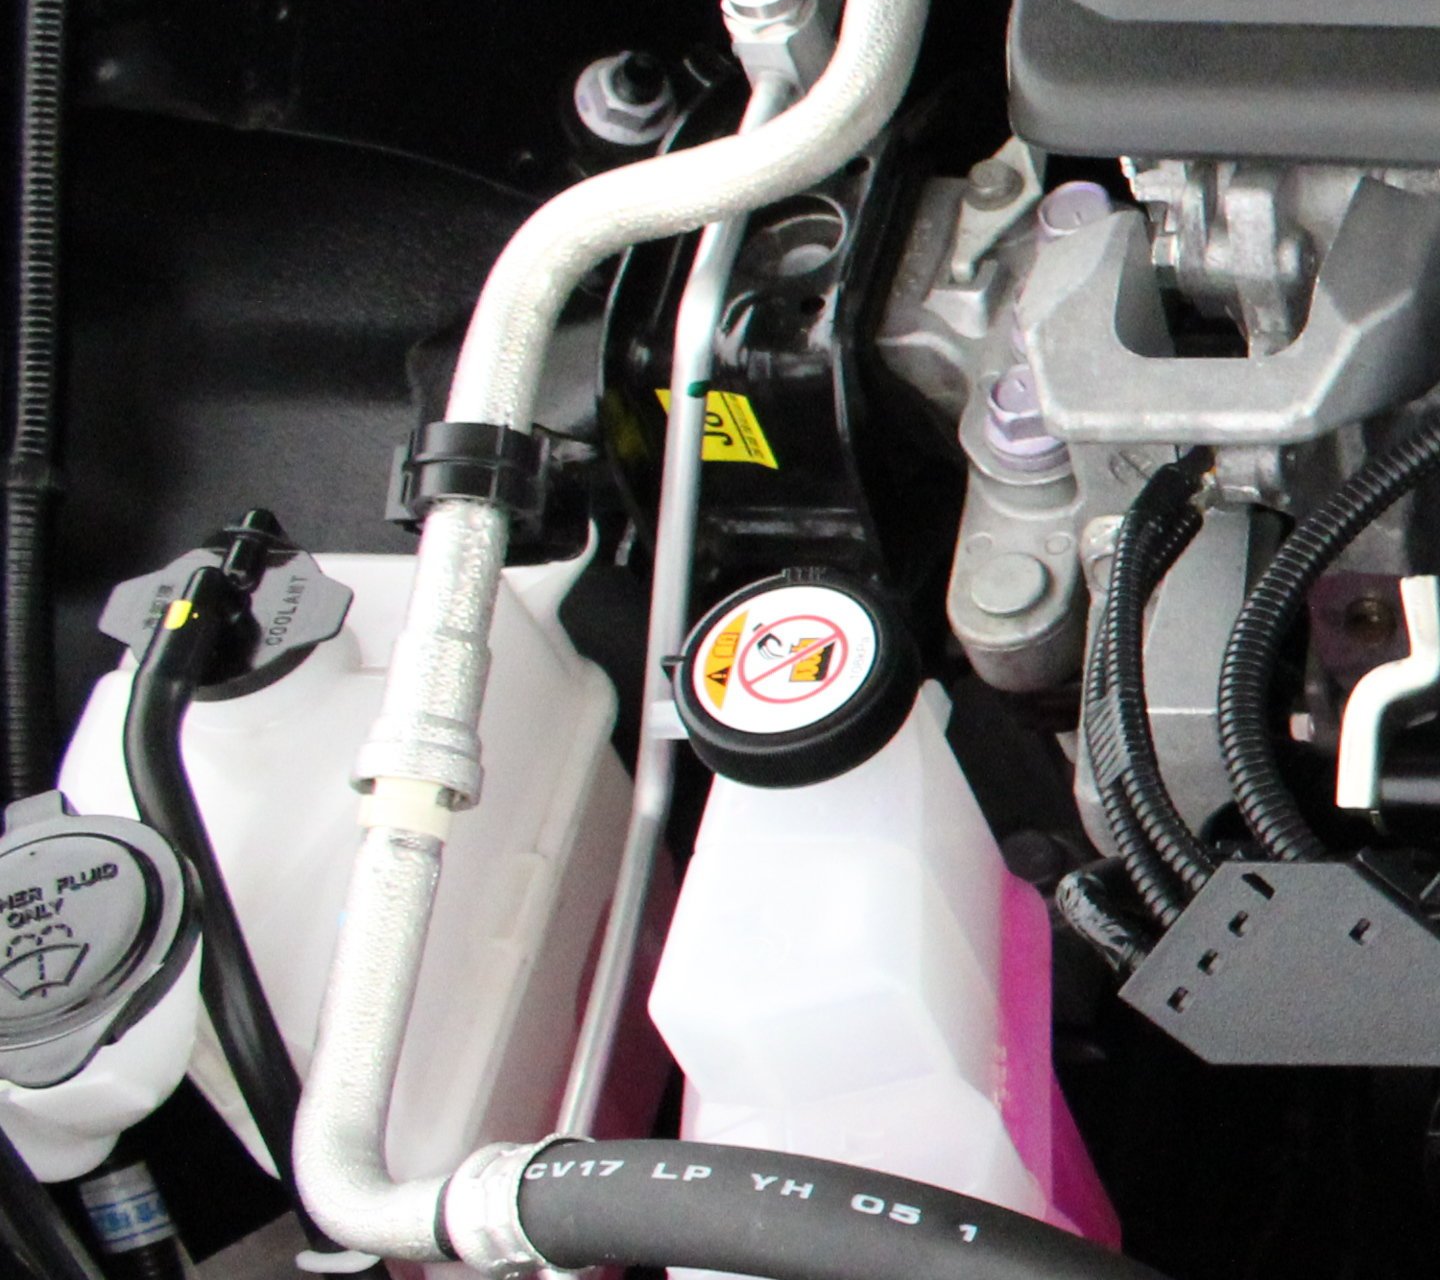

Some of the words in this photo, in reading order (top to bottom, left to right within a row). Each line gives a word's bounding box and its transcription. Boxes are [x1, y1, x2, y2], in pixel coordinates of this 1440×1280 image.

[264, 574, 308, 648] COOLANT
[56, 862, 119, 895] FLUID
[7, 897, 64, 930] ONLY
[650, 1161, 712, 1182] LP
[750, 1173, 815, 1200] YH
[850, 1193, 923, 1226] 05
